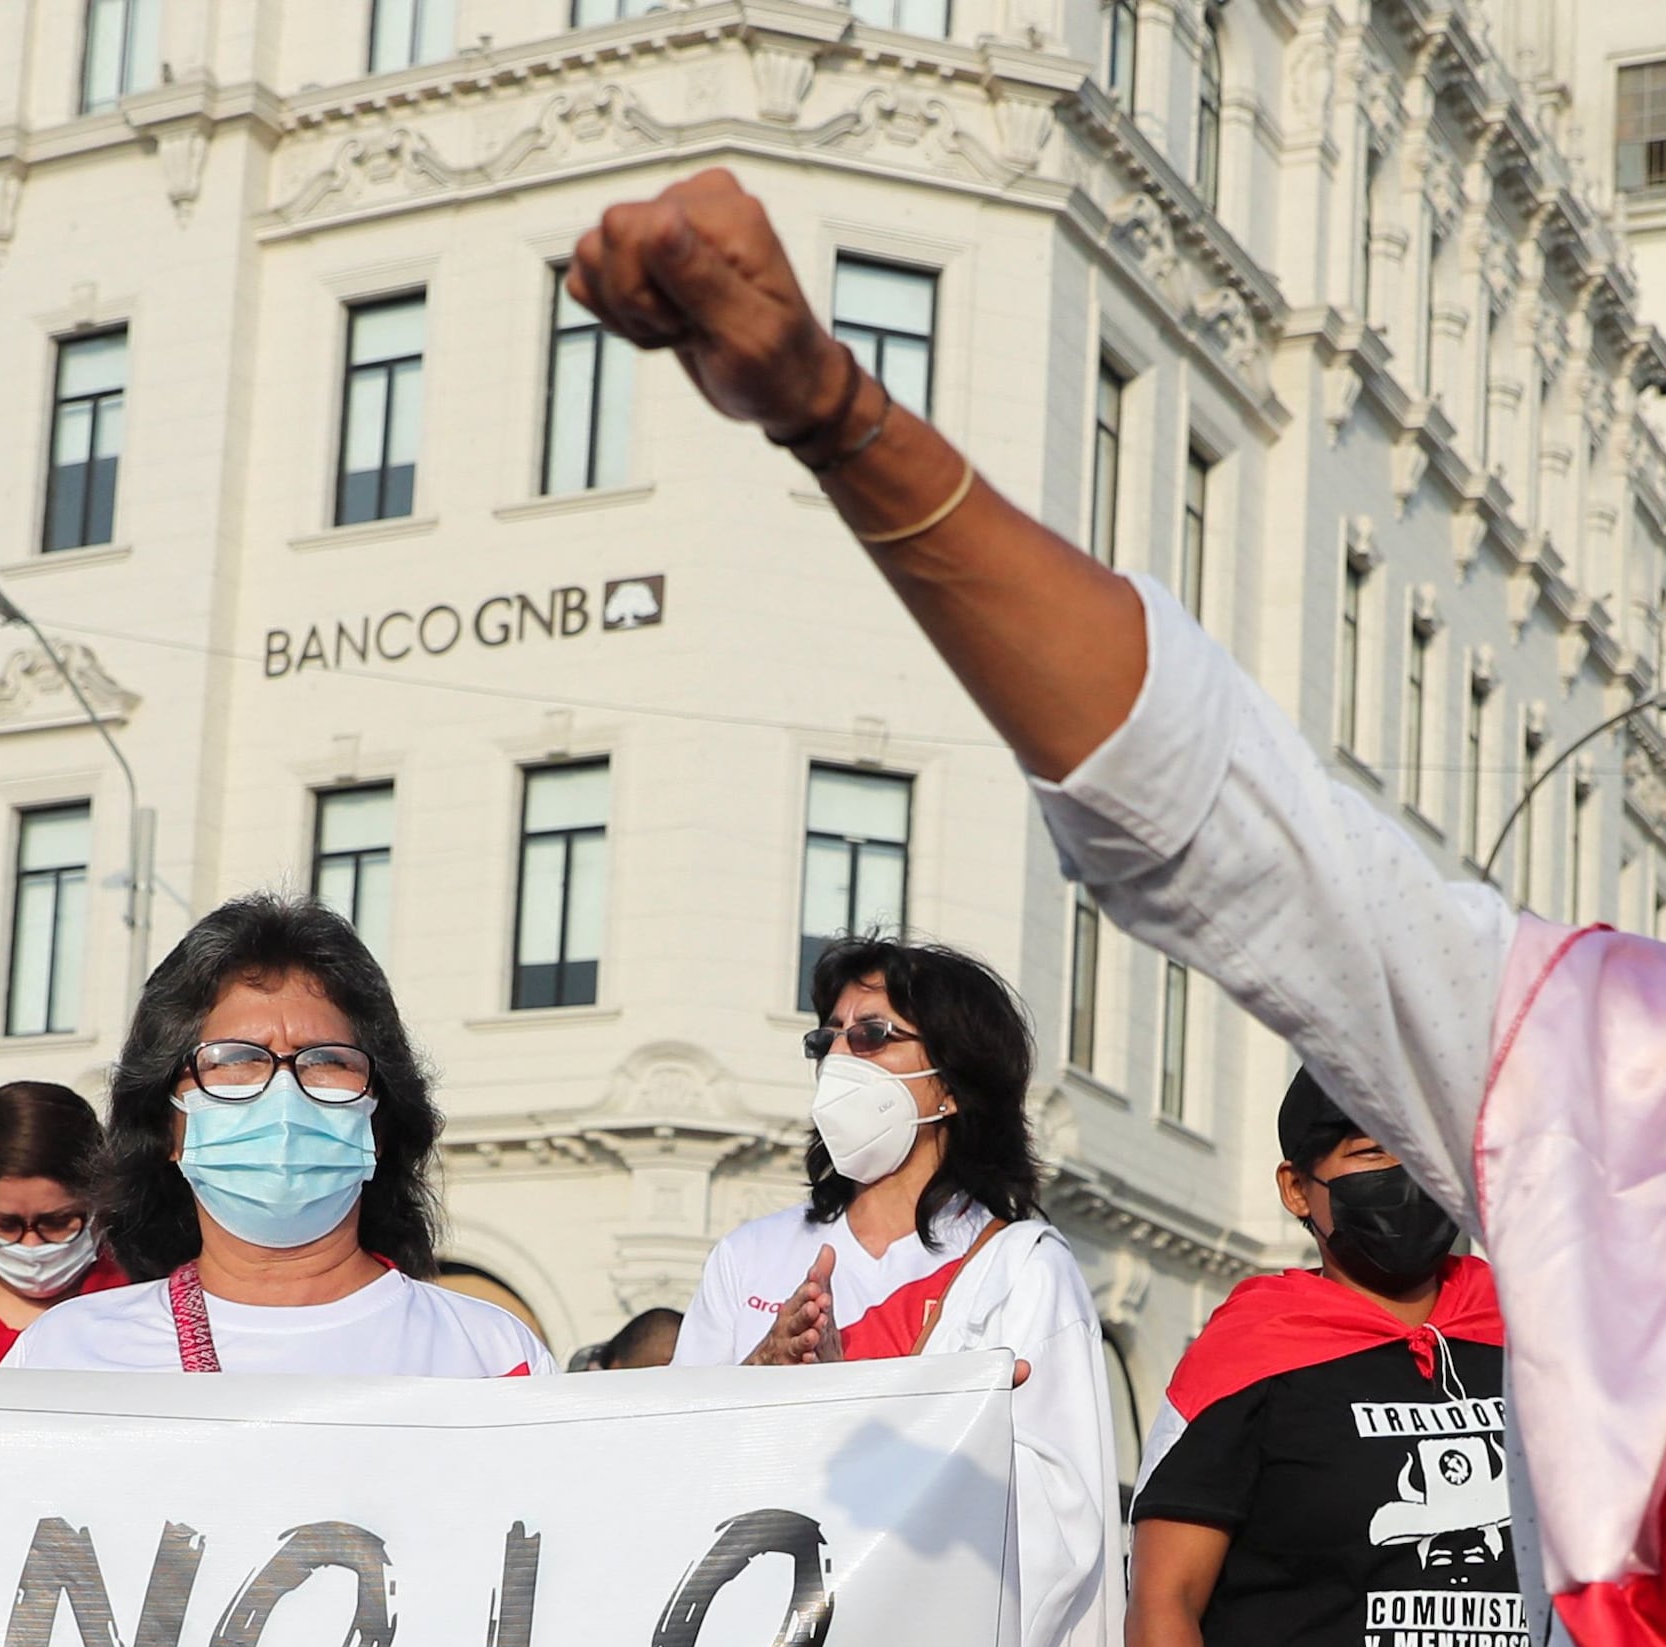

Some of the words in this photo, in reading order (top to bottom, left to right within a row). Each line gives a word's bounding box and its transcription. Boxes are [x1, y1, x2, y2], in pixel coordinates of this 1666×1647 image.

[264, 604, 462, 679] BANCO
[472, 585, 591, 648] GNB
[1371, 1595, 1528, 1629] COMUNISTA
